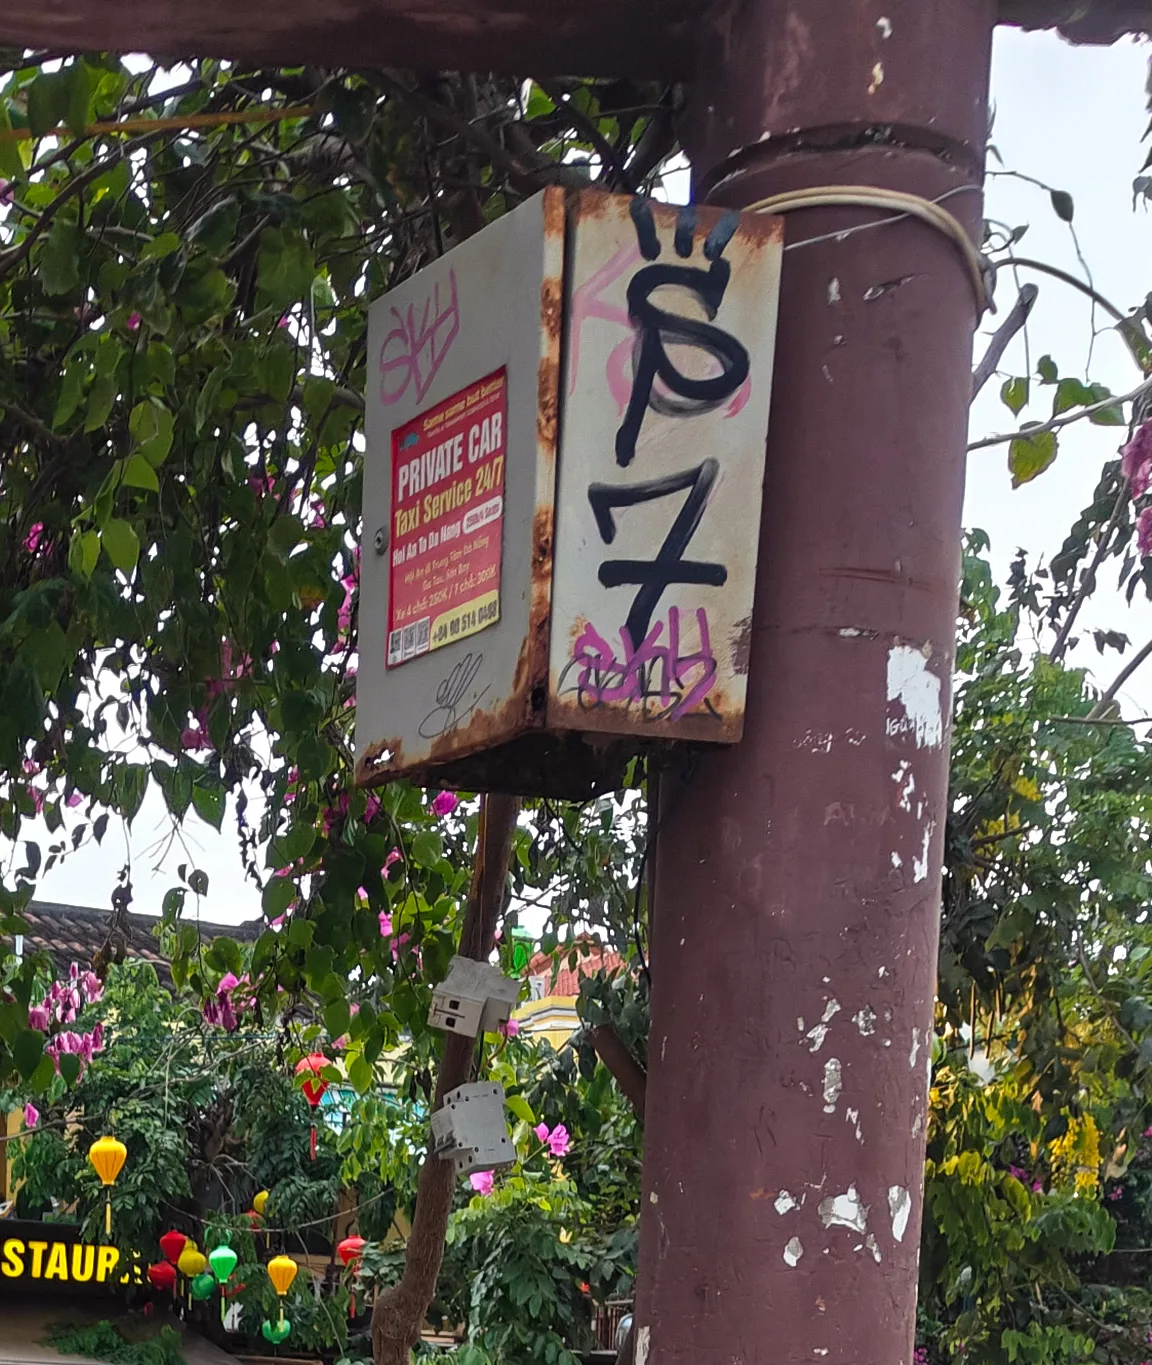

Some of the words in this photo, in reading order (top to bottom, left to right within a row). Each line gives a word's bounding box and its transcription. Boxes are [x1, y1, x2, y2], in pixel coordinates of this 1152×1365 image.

[394, 500, 420, 538] Taxi
[423, 478, 472, 524] Service
[475, 455, 504, 497] 24/7
[398, 432, 464, 503] PRIVATE
[468, 411, 502, 464] CAR
[406, 542, 418, 561] An
[418, 536, 428, 555] To
